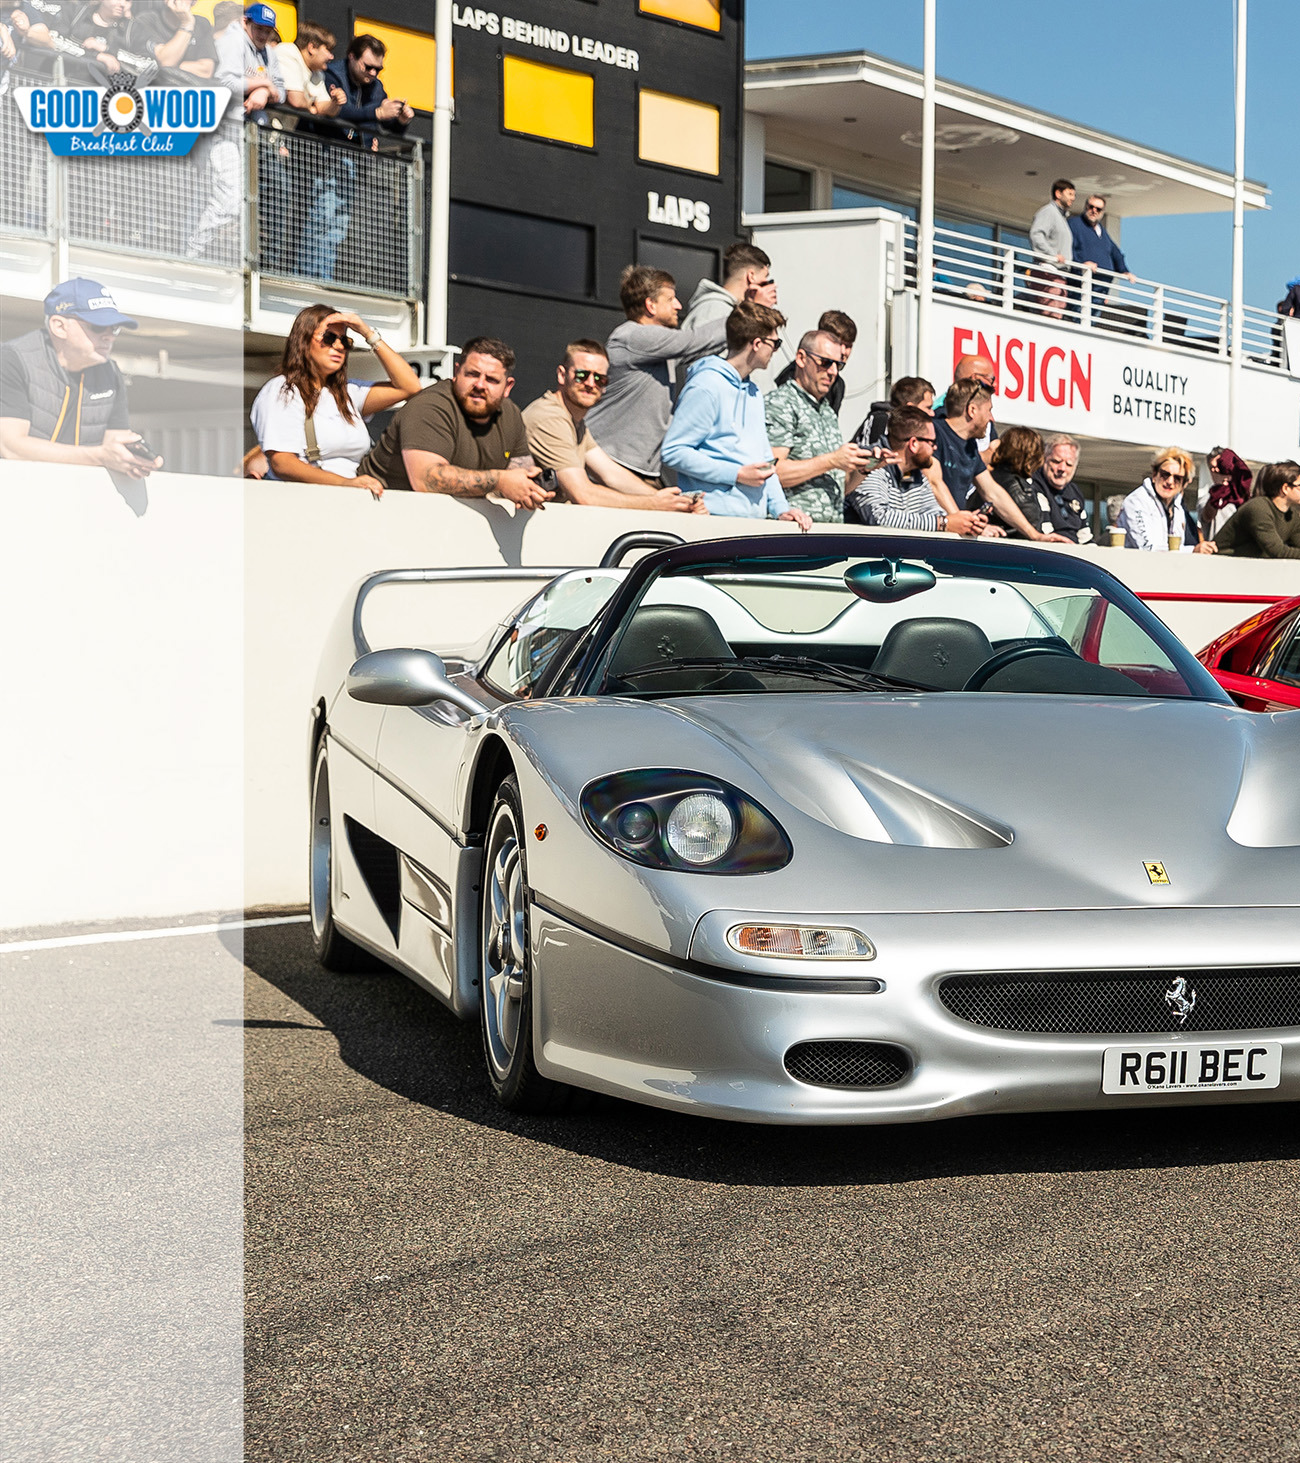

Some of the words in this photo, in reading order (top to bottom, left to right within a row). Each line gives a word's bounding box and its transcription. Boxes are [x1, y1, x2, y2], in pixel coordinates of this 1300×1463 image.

[452, 4, 500, 36] LAPS
[501, 17, 570, 54] BEHIND
[572, 35, 640, 72] LEADER
[647, 191, 711, 233] LAPS
[1122, 366, 1189, 396] QUALITY
[1112, 394, 1197, 427] BATTERIES
[1119, 1051, 1188, 1087] R611
[1198, 1048, 1268, 1083] BEC
